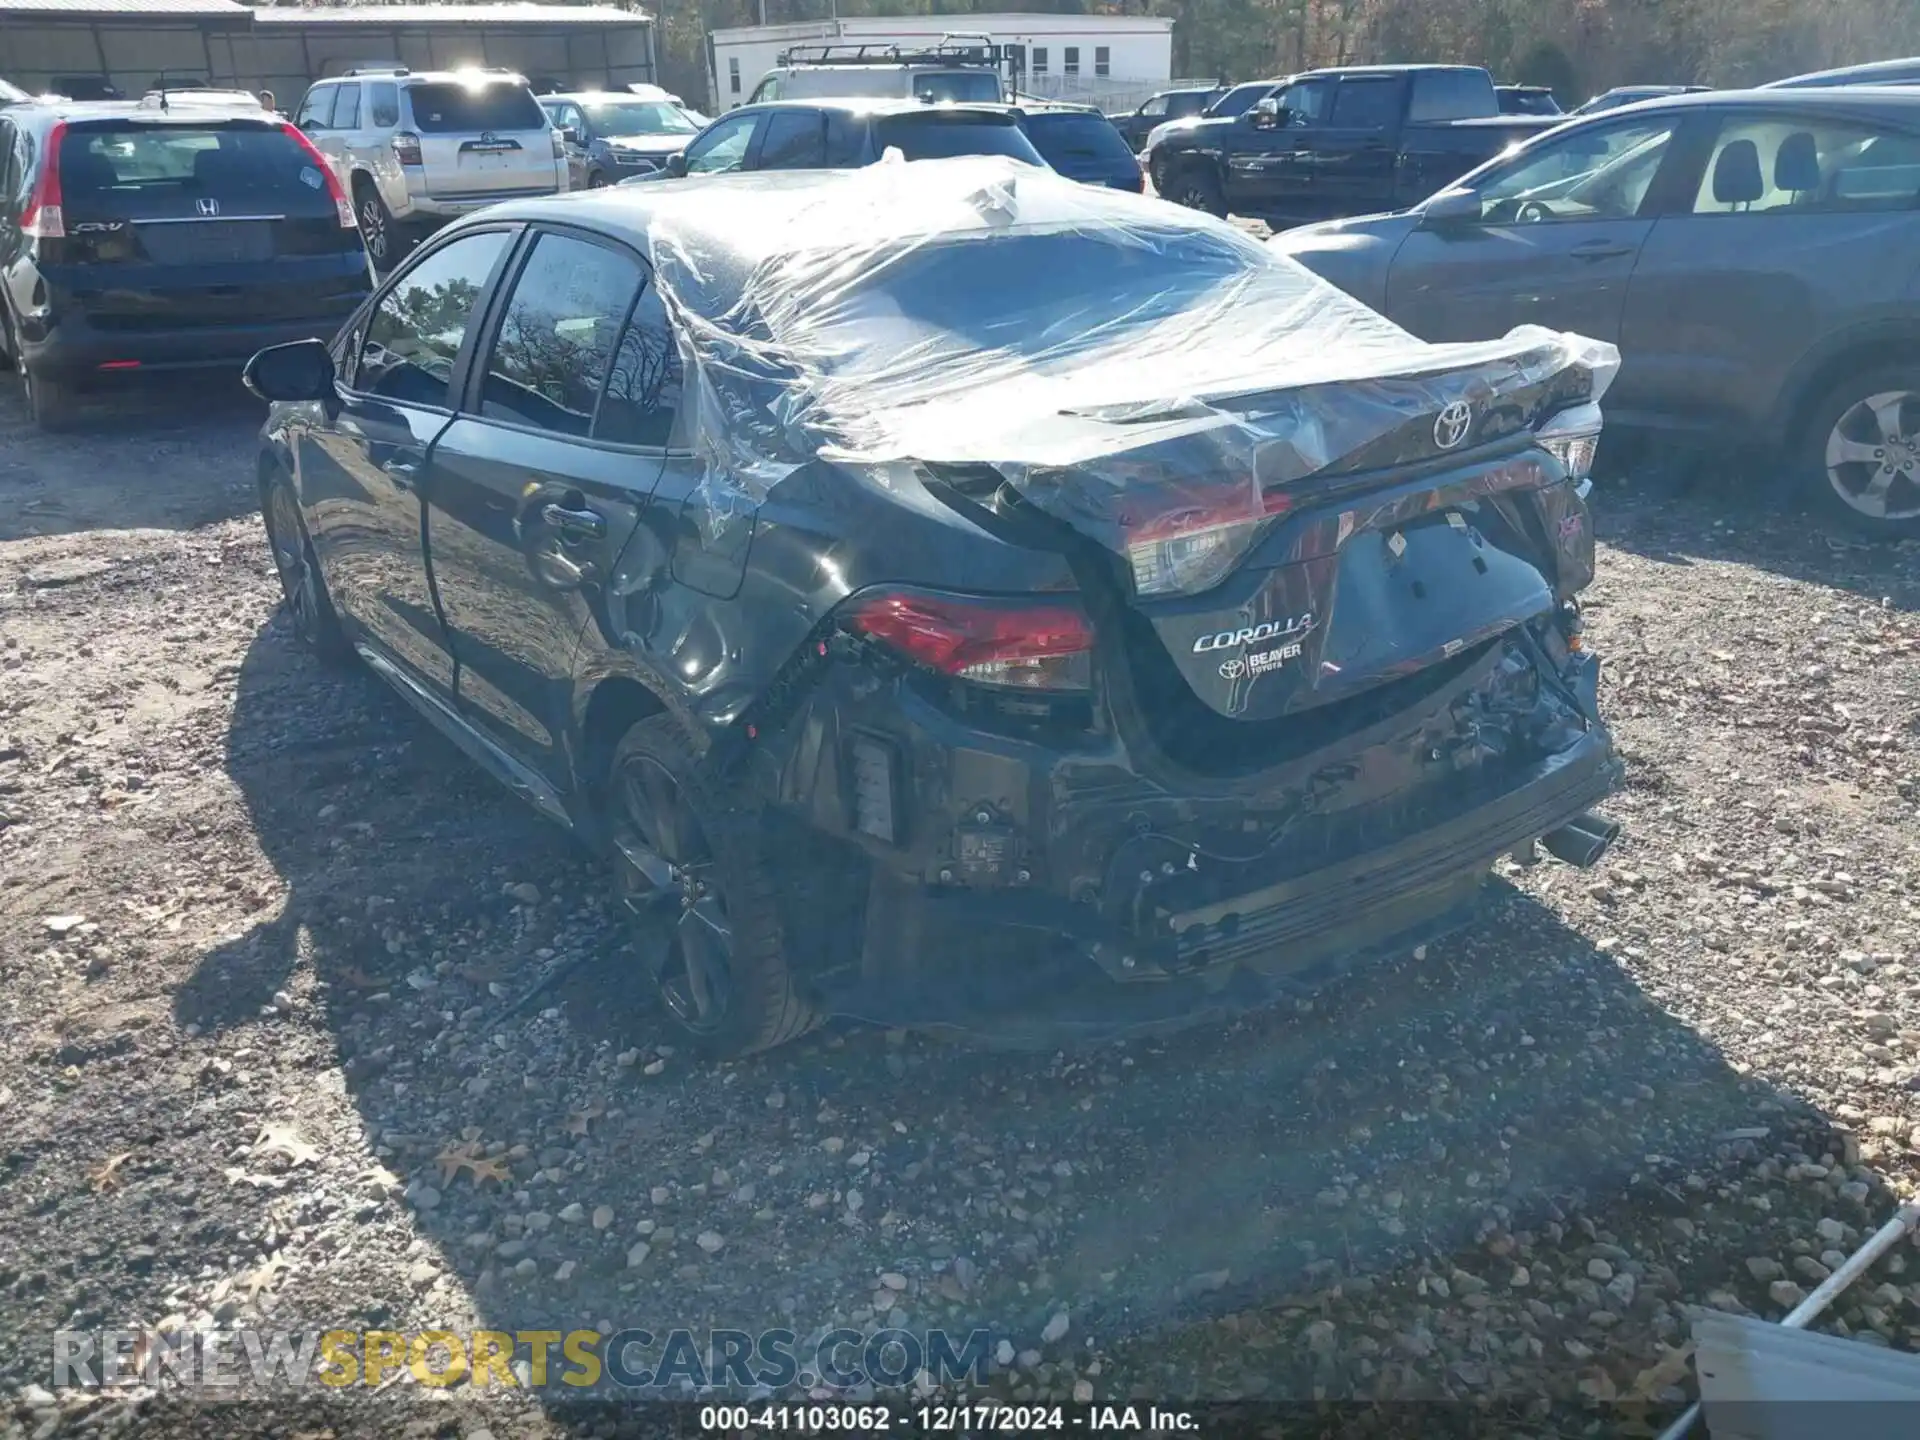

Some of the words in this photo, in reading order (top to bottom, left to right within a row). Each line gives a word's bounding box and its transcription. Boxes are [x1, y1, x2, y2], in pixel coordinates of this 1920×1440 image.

[1193, 613, 1312, 653] COROLLA
[1249, 643, 1301, 667] BEAVER
[1251, 661, 1282, 674] TOYOTA
